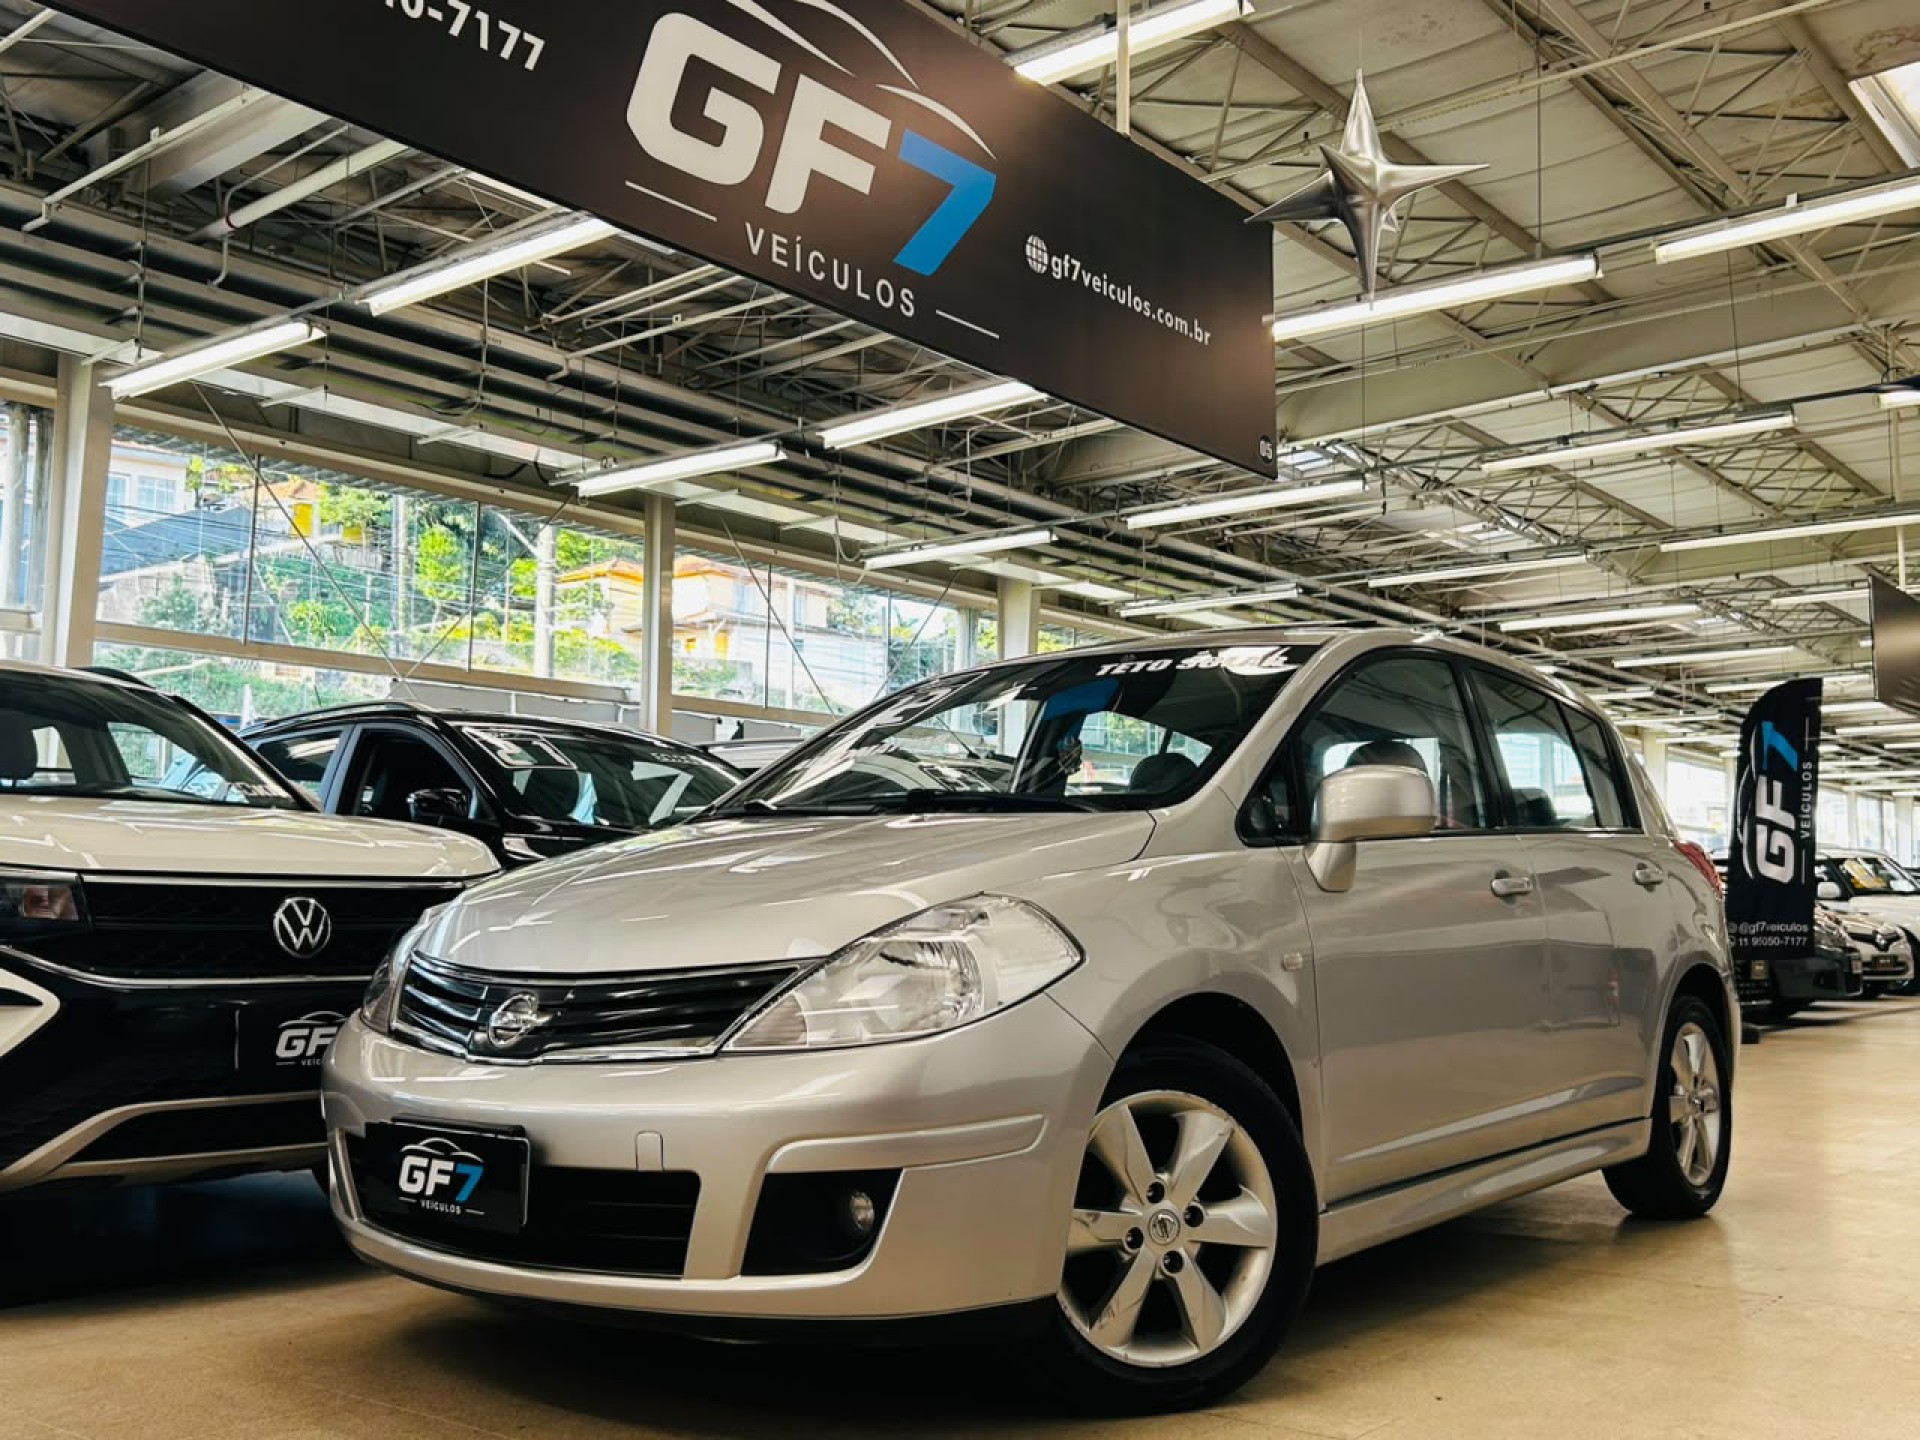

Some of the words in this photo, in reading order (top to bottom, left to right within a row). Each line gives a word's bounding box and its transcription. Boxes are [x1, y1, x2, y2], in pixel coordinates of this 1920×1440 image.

[386, 0, 546, 71] 0-7177
[626, 11, 997, 277] GF7
[745, 222, 917, 318] VEÍCULOS
[1051, 253, 1212, 346] gf7veiculos.com.br
[1095, 658, 1174, 676] TETO
[1755, 721, 1799, 884] GF7
[399, 1155, 484, 1203] GF7
